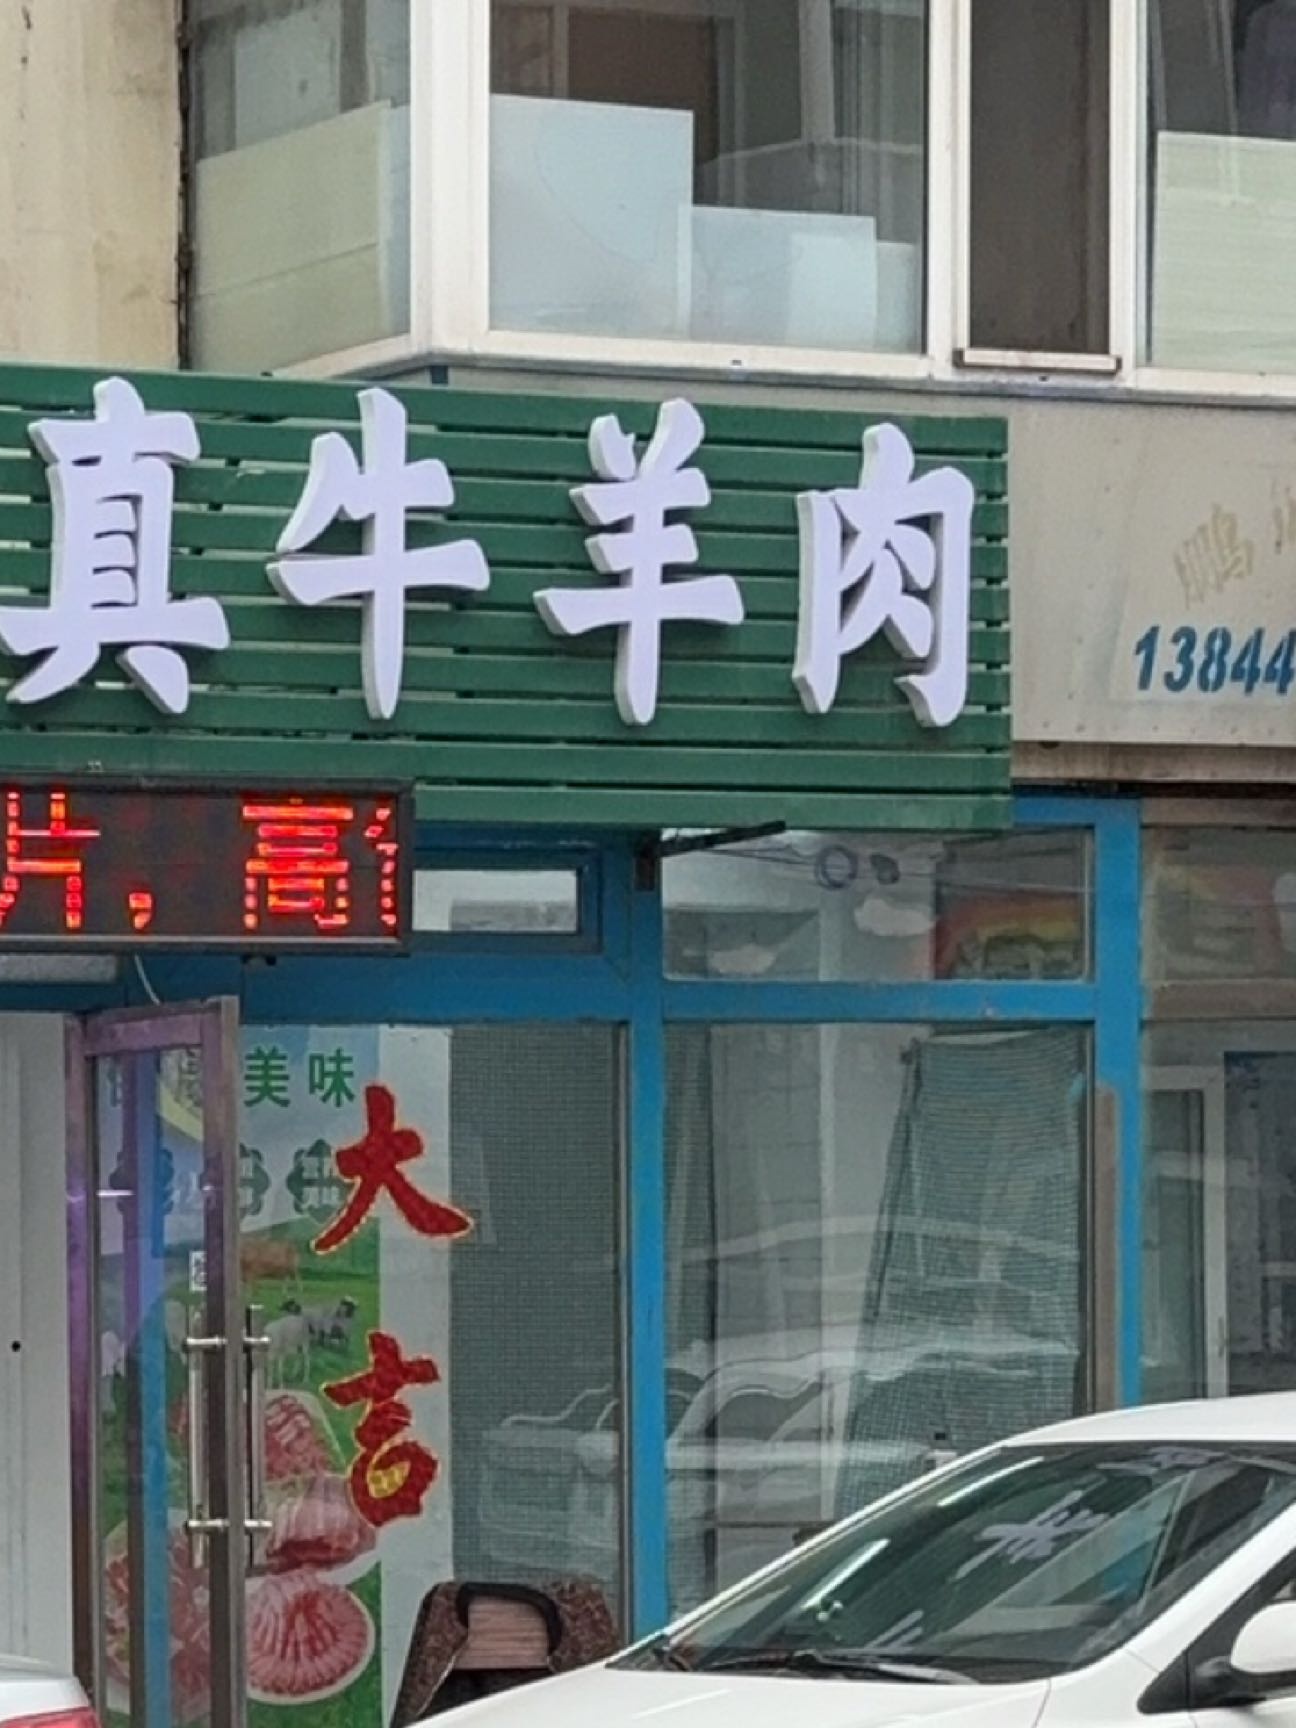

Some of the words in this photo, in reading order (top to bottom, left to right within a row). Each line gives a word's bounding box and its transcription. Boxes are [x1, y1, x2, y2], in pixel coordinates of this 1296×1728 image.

[1135, 625, 1296, 696] 13844
[243, 1045, 356, 1108] 美味
[310, 1082, 474, 1529] 大吉
